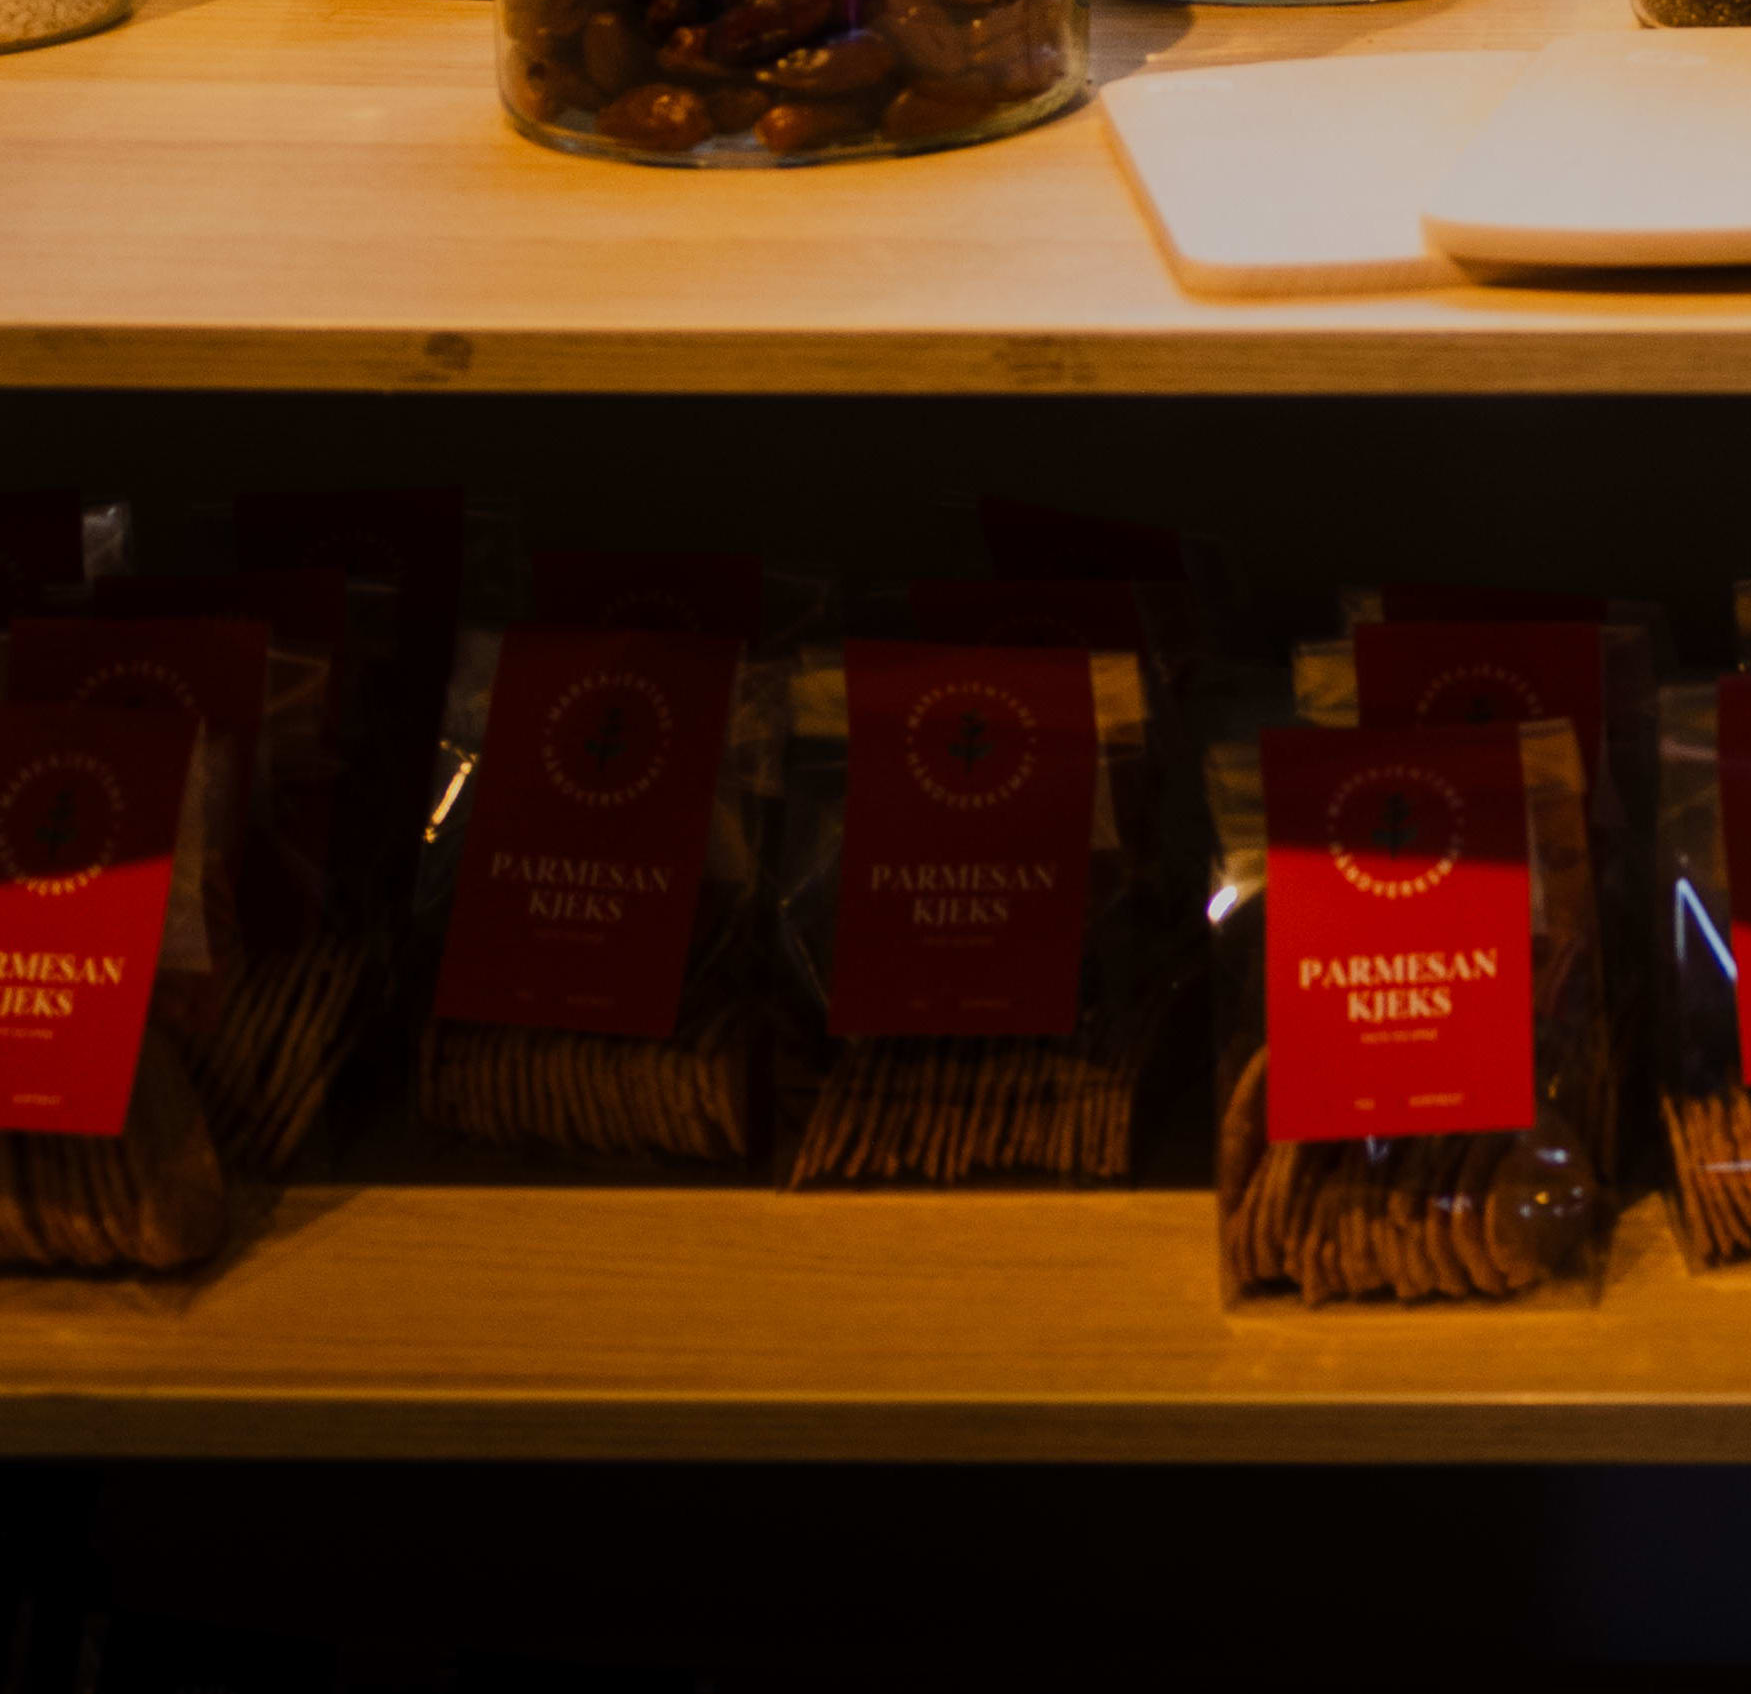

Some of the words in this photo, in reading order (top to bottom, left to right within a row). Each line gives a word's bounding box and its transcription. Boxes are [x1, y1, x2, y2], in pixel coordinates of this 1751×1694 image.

[487, 852, 672, 895] PARMESAN
[870, 862, 1058, 893] PARMESAN
[526, 891, 624, 924] KJEKS
[911, 895, 1011, 928] KJEKS
[1298, 948, 1498, 991] PARMESAN
[0, 985, 75, 1018] JEKS
[1346, 986, 1453, 1025] KJEKS
